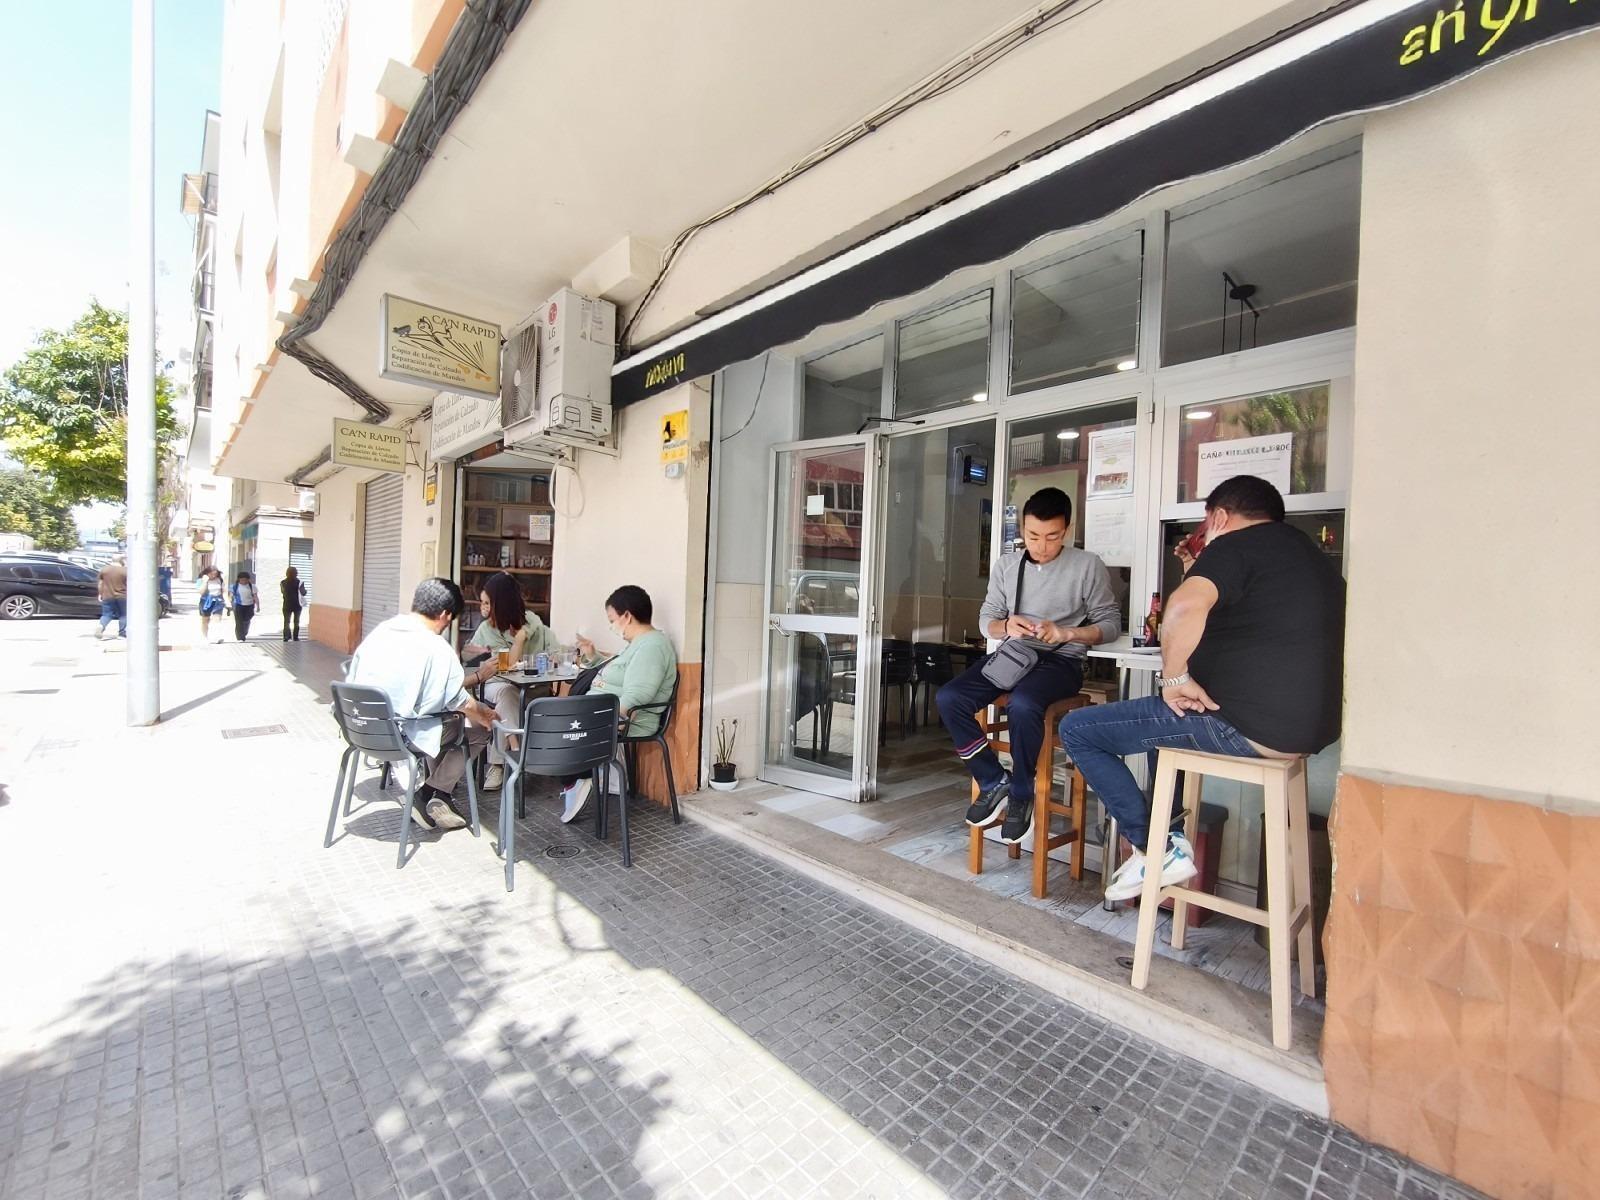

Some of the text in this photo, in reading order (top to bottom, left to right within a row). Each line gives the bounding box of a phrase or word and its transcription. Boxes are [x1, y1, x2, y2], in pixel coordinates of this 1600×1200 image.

[463, 322, 496, 339] RAPID
[548, 326, 556, 340] LG
[391, 346, 411, 355] Copia
[437, 364, 462, 374] Calzado
[441, 372, 466, 382] Mandos
[340, 427, 401, 444] CA'N RAPID
